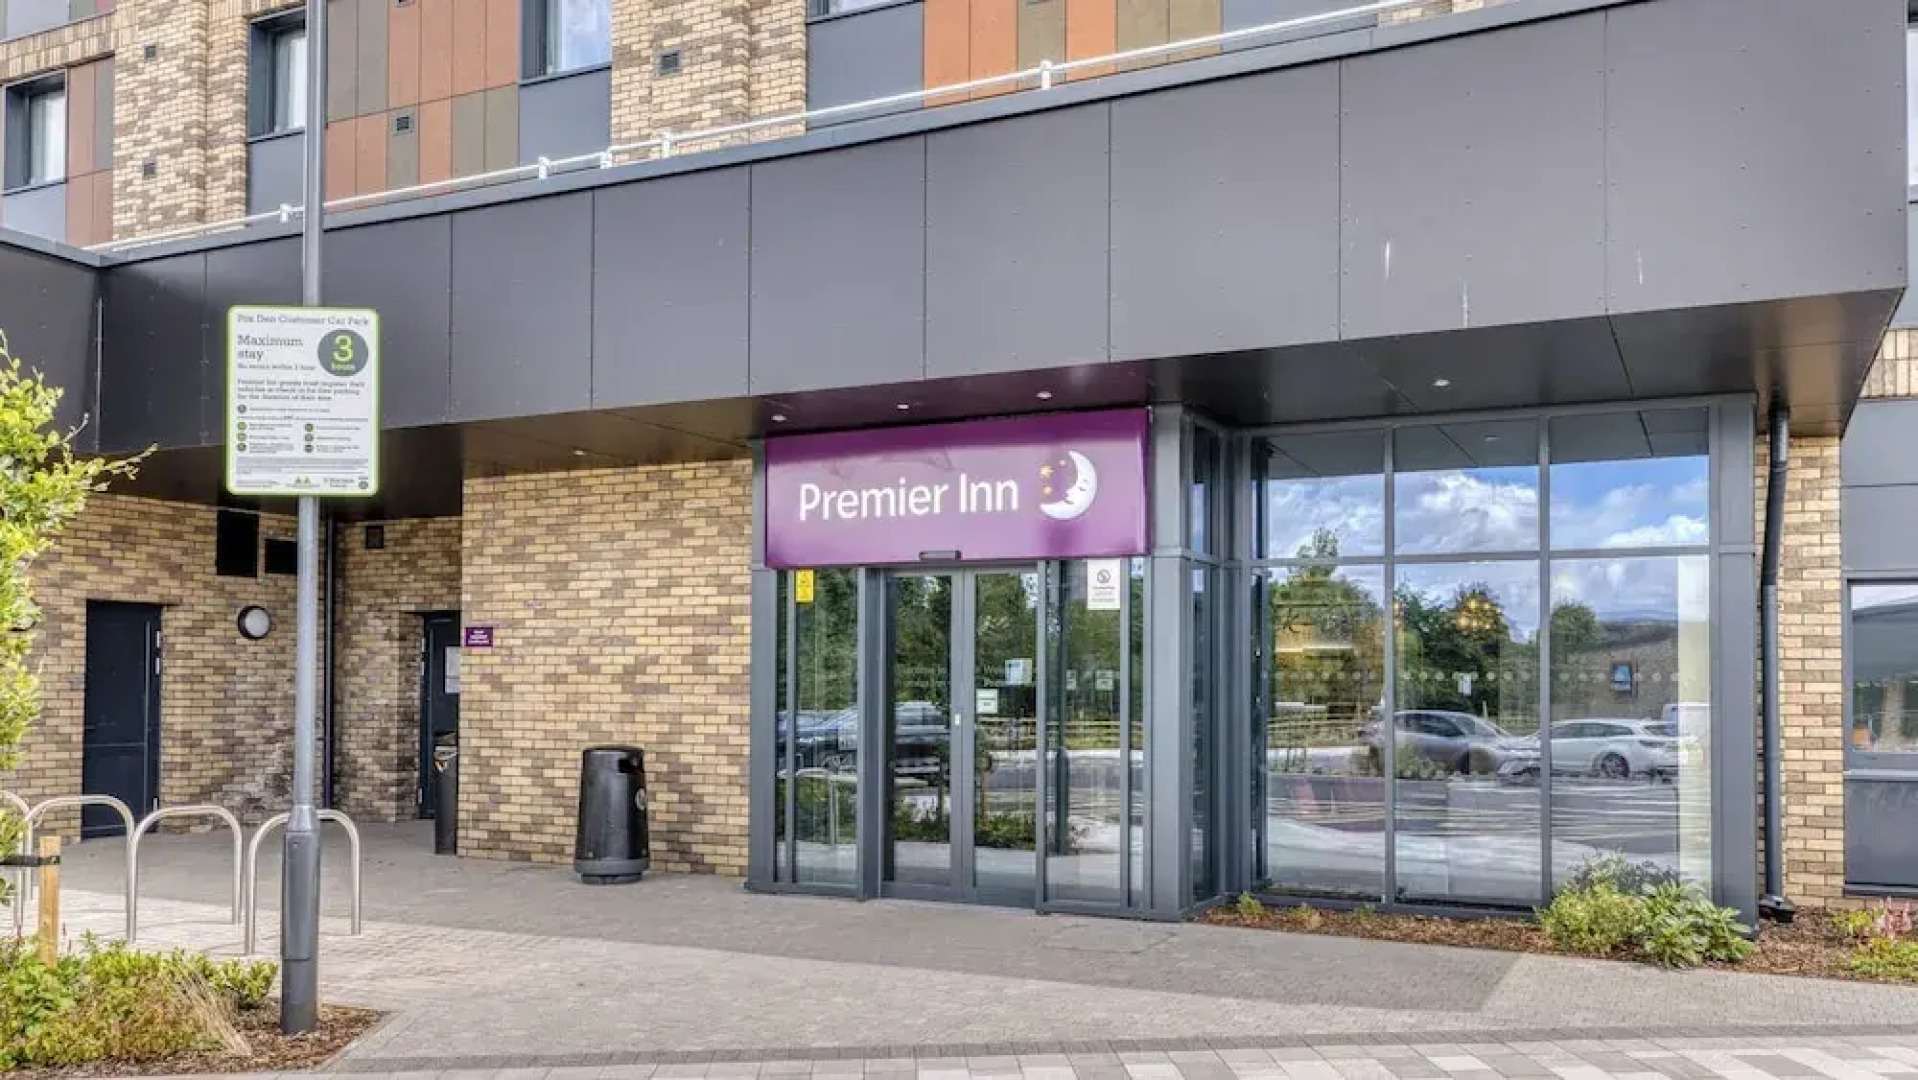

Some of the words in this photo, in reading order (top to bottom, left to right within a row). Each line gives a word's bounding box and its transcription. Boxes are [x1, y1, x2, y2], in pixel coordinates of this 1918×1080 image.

[237, 334, 303, 347] Maximum
[333, 334, 354, 362] 3
[237, 349, 265, 363] stay
[799, 476, 950, 522] Premier
[959, 472, 1020, 514] Inn
